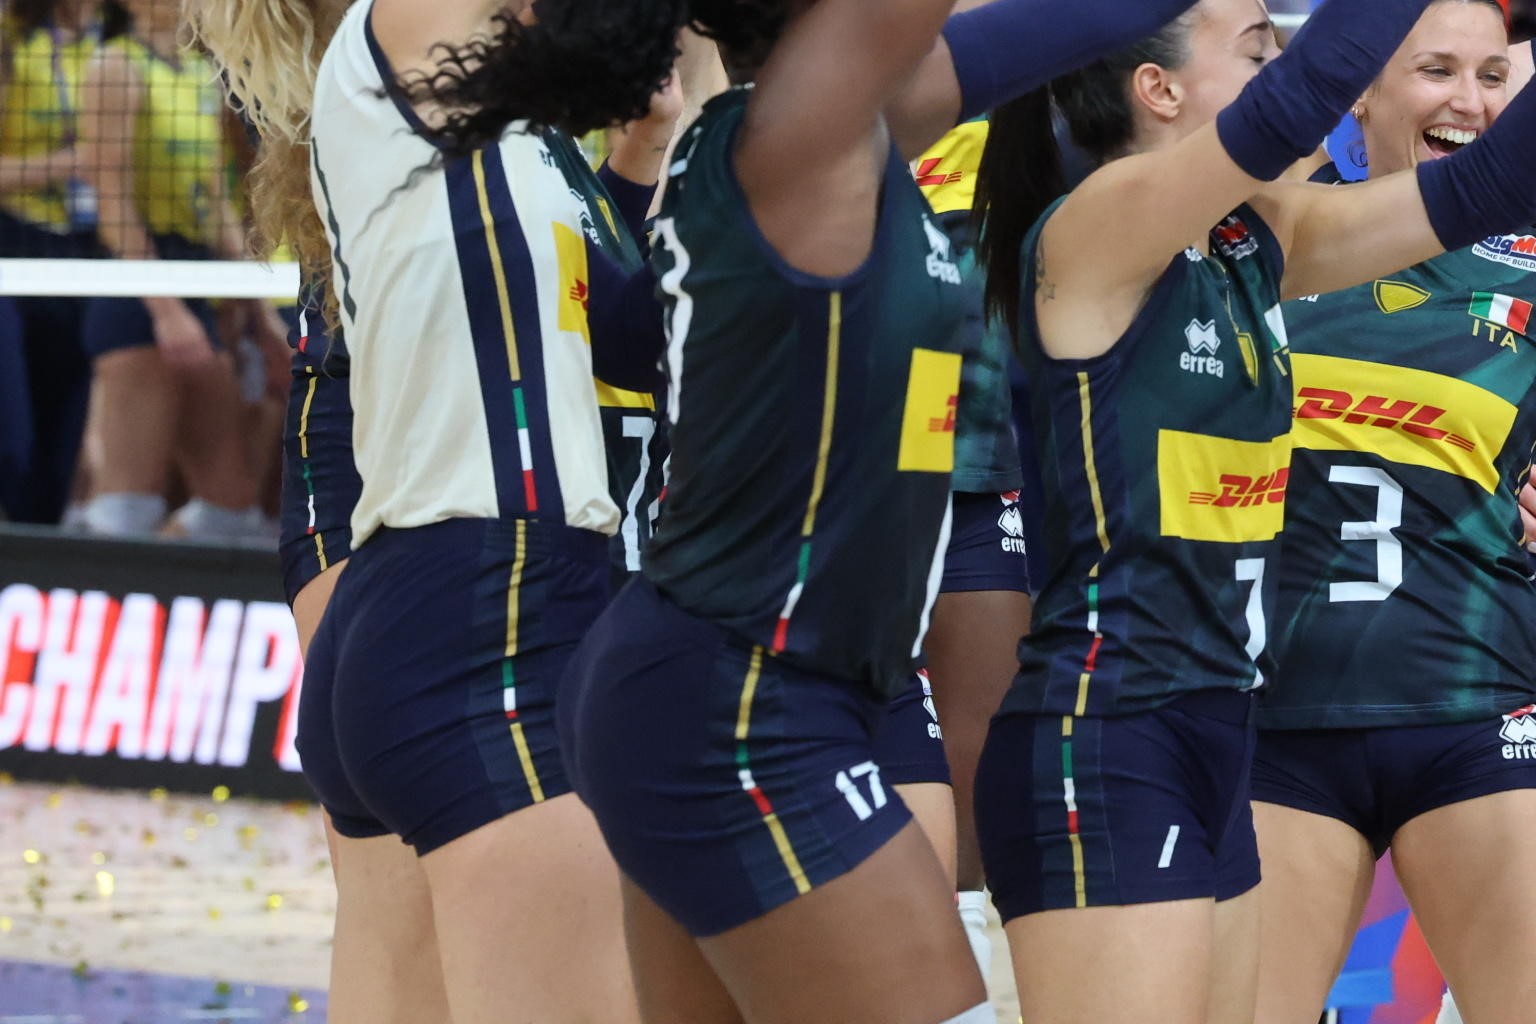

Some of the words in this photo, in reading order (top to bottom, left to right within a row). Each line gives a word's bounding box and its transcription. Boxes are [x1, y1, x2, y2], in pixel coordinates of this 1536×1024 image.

[1180, 351, 1223, 379] errea
[1472, 319, 1518, 354] ITA
[1297, 387, 1448, 441] DHL
[1329, 465, 1403, 603] 3
[1235, 558, 1266, 691] 7
[835, 761, 888, 822] 17
